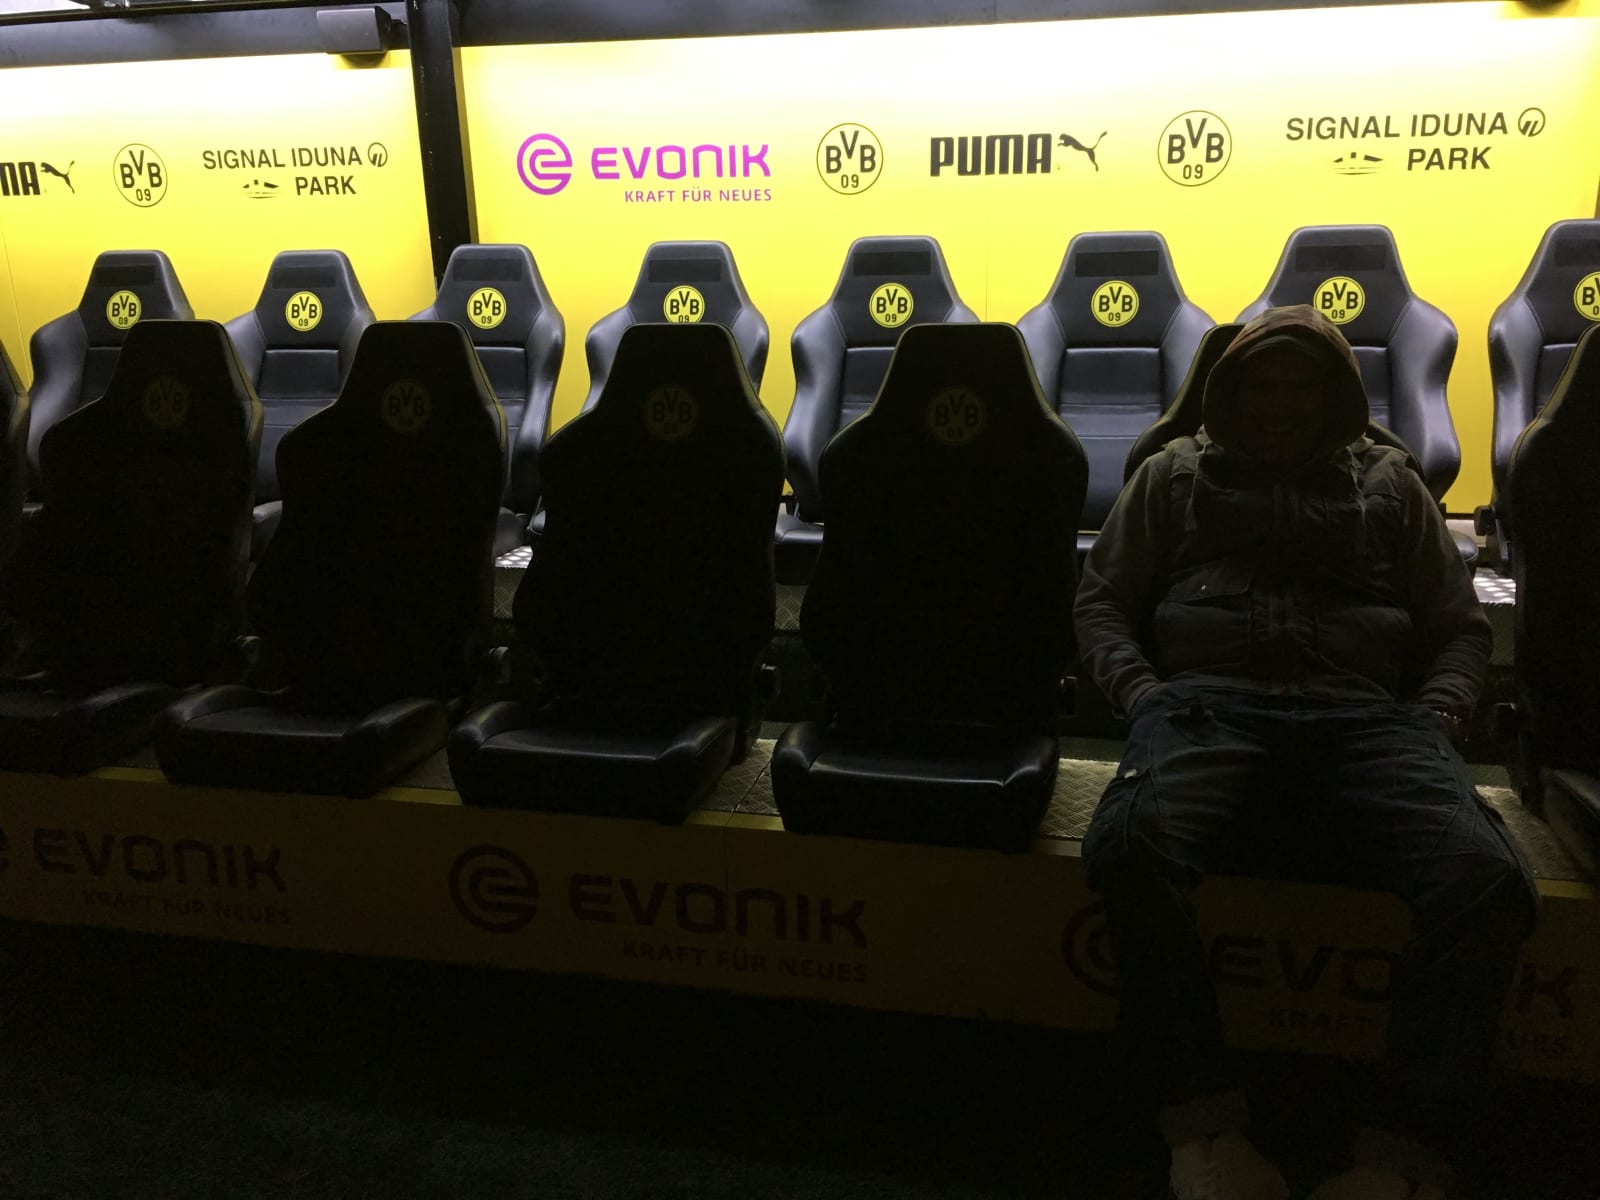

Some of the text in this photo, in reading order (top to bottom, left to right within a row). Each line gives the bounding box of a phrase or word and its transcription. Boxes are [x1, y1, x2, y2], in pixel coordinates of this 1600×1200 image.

[1285, 112, 1509, 141] SIGNAL IDUNA
[825, 130, 877, 174] BVB
[1167, 117, 1225, 164] BVB
[201, 145, 363, 170] SIGNAL IDUNA
[590, 144, 771, 180] EVONIK
[930, 133, 1052, 177] PUMA
[1407, 146, 1492, 171] PARK
[119, 150, 163, 189] BVB
[840, 174, 860, 189] 09
[1182, 164, 1204, 180] 09
[135, 188, 152, 202] 09
[295, 175, 357, 195] PARK
[624, 187, 773, 203] KRAFT FÜR NEUES
[112, 295, 137, 317] BVB
[291, 296, 318, 318] BVB
[473, 292, 502, 316] BVB
[669, 290, 700, 315] BVB
[876, 288, 908, 313] BVB
[1098, 286, 1134, 312] BVB
[1321, 282, 1359, 310] BVB
[118, 317, 129, 325] 09
[298, 318, 309, 326] 09
[480, 315, 493, 324] 09
[884, 313, 897, 323] 09
[1108, 312, 1121, 322] 09
[1331, 309, 1346, 319] 09
[33, 827, 288, 893] EVONIK
[569, 872, 867, 948] EVONIK
[623, 940, 708, 966] KRAFT
[779, 957, 867, 983] NEUES
